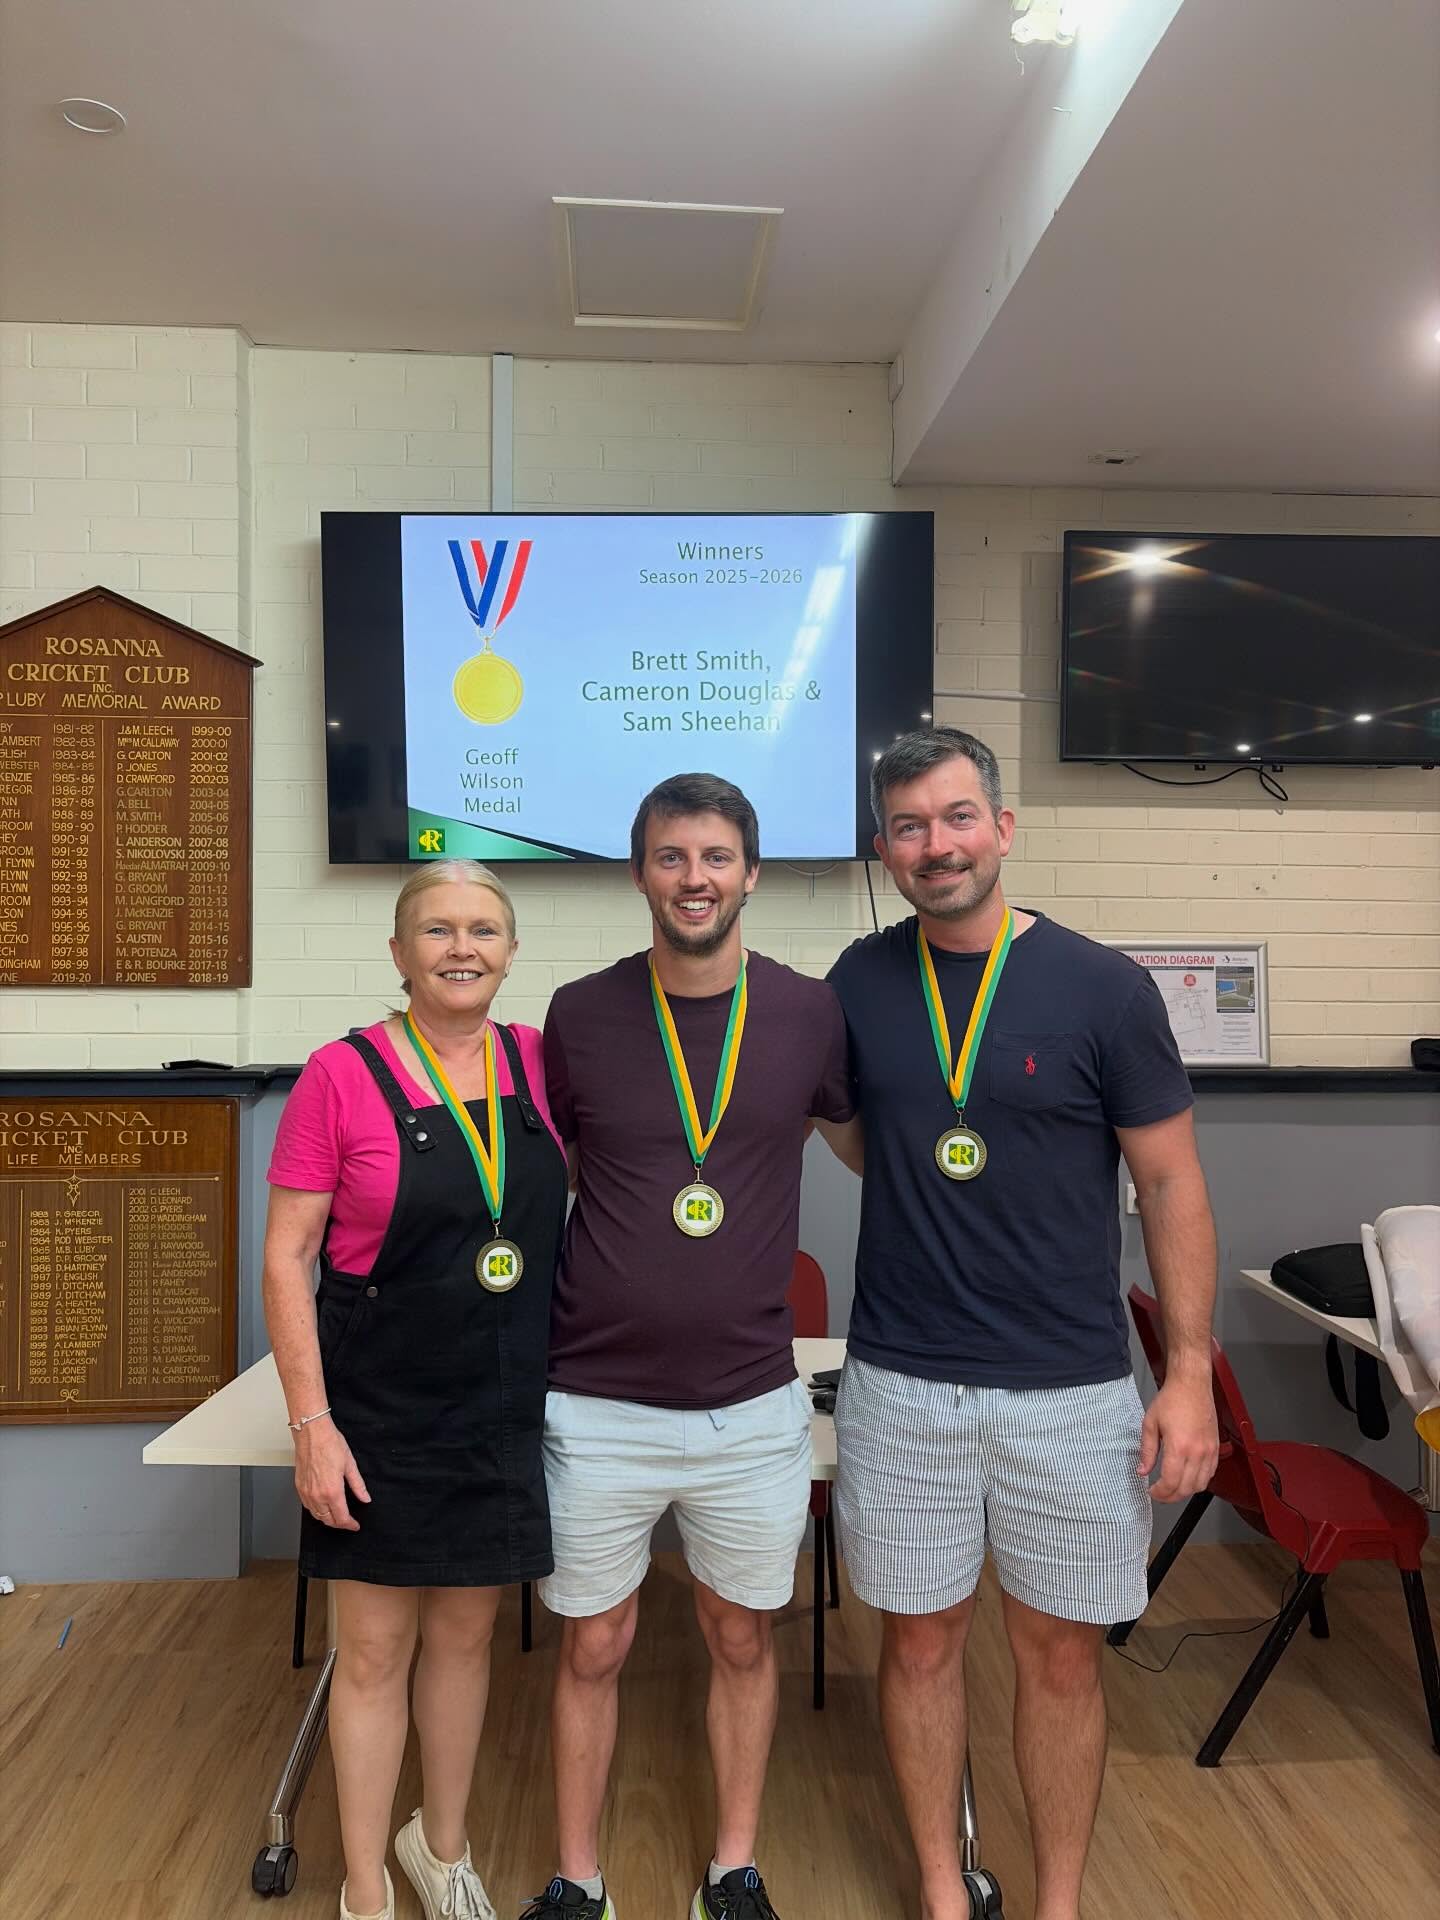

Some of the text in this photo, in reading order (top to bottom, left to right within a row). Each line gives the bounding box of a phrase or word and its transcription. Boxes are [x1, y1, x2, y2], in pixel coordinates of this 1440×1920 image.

[678, 542, 764, 560] Winners
[640, 569, 698, 584] Season
[45, 637, 164, 658] ROSANNA
[632, 650, 771, 673] Brett Smith,
[7, 663, 190, 684] CRICKET CLUB
[582, 679, 821, 705] Cameron Douglas &
[61, 693, 148, 709] MEMORIAL
[161, 695, 221, 711] AWARD
[623, 710, 781, 731] Sam Sheehan
[53, 723, 95, 734] 1981-82
[143, 725, 173, 736] LEECH
[191, 726, 232, 736] 1999-00
[52, 737, 96, 747] 1982-83
[140, 738, 180, 748] CALLAWAY
[52, 750, 96, 760] 1983-84
[128, 751, 172, 761] CARLTON
[190, 752, 228, 761] 2001-02
[465, 748, 519, 765] Geoff
[125, 763, 158, 772] JONES
[190, 764, 229, 773] 2001-02
[52, 773, 95, 783] 1985-86
[125, 774, 176, 784] CRAWFORD
[460, 772, 523, 789] Wilson
[52, 785, 94, 795] 1986-87
[126, 787, 172, 797] CARLTON
[52, 797, 94, 808] 1987-88
[128, 799, 151, 809] BELL
[465, 796, 521, 813] Medal
[129, 812, 162, 821] SMITH
[0, 821, 95, 832] ROOM 1989-90
[125, 824, 168, 834] HODDER
[51, 834, 89, 844] 1990-91
[125, 836, 182, 847] ANDERSON
[188, 837, 229, 848] 2007-08
[51, 846, 89, 856] 1991-92
[127, 849, 185, 859] NIKOLOVSKI
[188, 849, 229, 859] 2008-09
[6, 858, 88, 869] FLYNN 1992-93
[0, 870, 88, 881] FLYNN 1992-93
[128, 872, 167, 882] BRYANT
[0, 883, 88, 893] FLYNN 1992-93
[128, 884, 168, 894] GROOM
[51, 896, 88, 907] 1993-94
[130, 896, 185, 906] LANGFORD
[51, 908, 88, 919] 1994-95
[124, 908, 174, 918] McKENZIE
[51, 921, 90, 932] 1995-96
[128, 921, 168, 931] BRYANT
[51, 934, 90, 944] 1996-97
[126, 933, 162, 944] AUSTIN
[188, 934, 229, 945] 2015-16
[51, 946, 89, 957] 1997-98
[131, 947, 178, 958] POTENZA
[188, 948, 229, 958] 2016-17
[51, 959, 89, 970] 1998-99
[146, 959, 186, 970] BOURKE
[188, 960, 227, 970] 2017-18
[1169, 955, 1215, 965] DIAGRAM
[51, 972, 92, 983] 2019-20
[124, 972, 157, 982] JONES
[188, 973, 229, 983] 2018-19
[118, 1130, 188, 1146] CLUB
[7, 1153, 142, 1165] LIFE MEMBERS
[74, 1235, 113, 1244] WEBSTER
[62, 1281, 104, 1290] DITCHAM
[65, 1291, 106, 1299] DITCHAM
[65, 1316, 101, 1324] WILSON
[63, 1340, 101, 1349] LAMBERT
